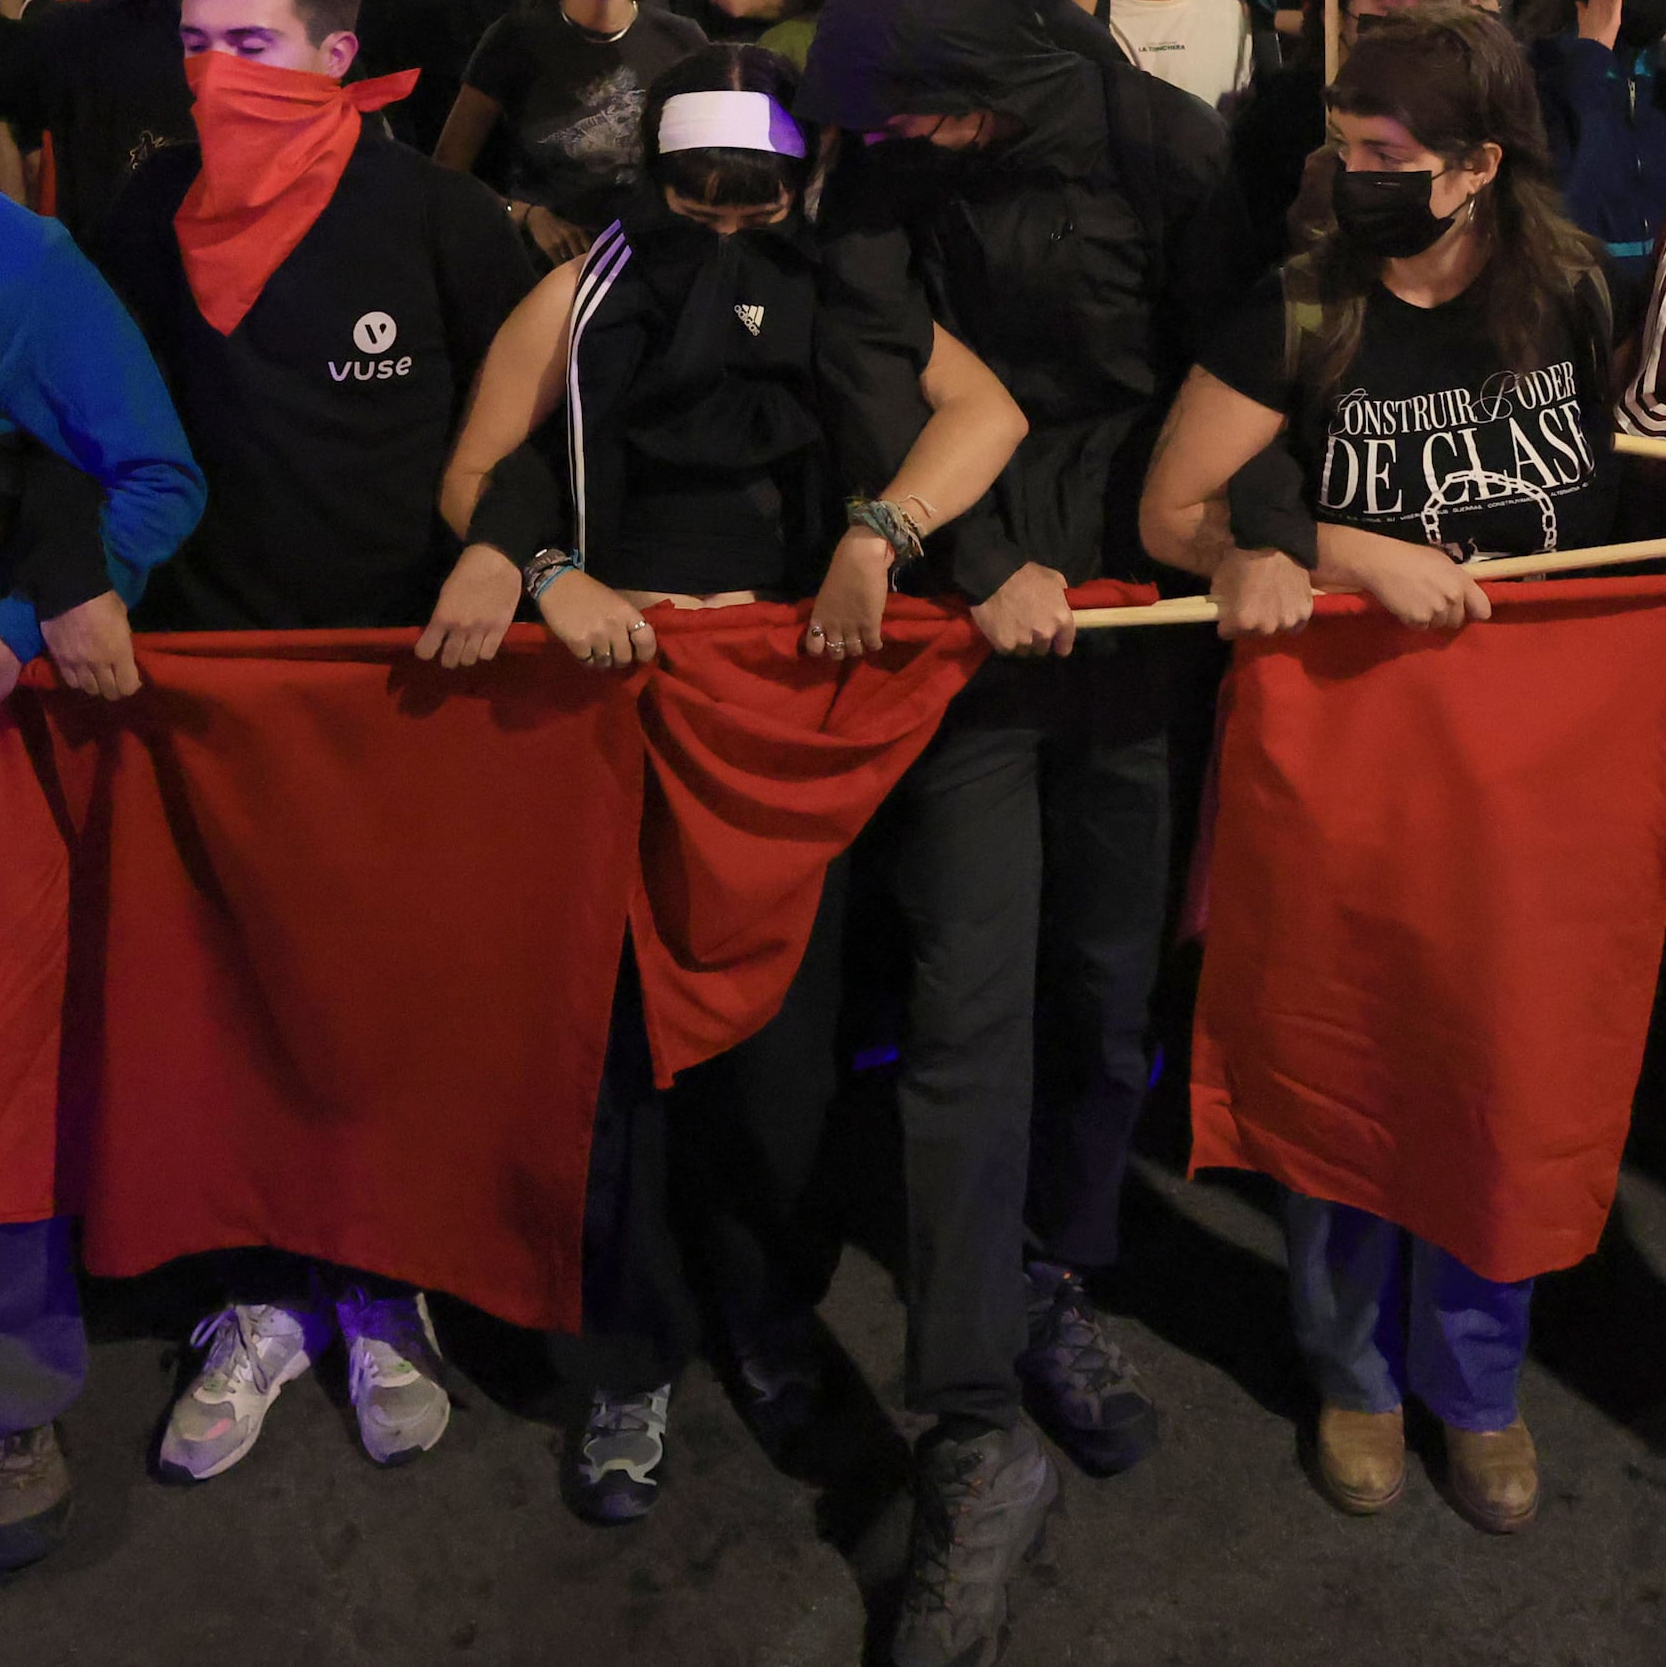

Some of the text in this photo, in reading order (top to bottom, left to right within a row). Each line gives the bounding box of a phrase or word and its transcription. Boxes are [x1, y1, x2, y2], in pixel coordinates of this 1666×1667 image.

[733, 304, 761, 337] adidas
[1328, 361, 1576, 436] CONSTRUIR PODER
[1319, 436, 1404, 515] DE
